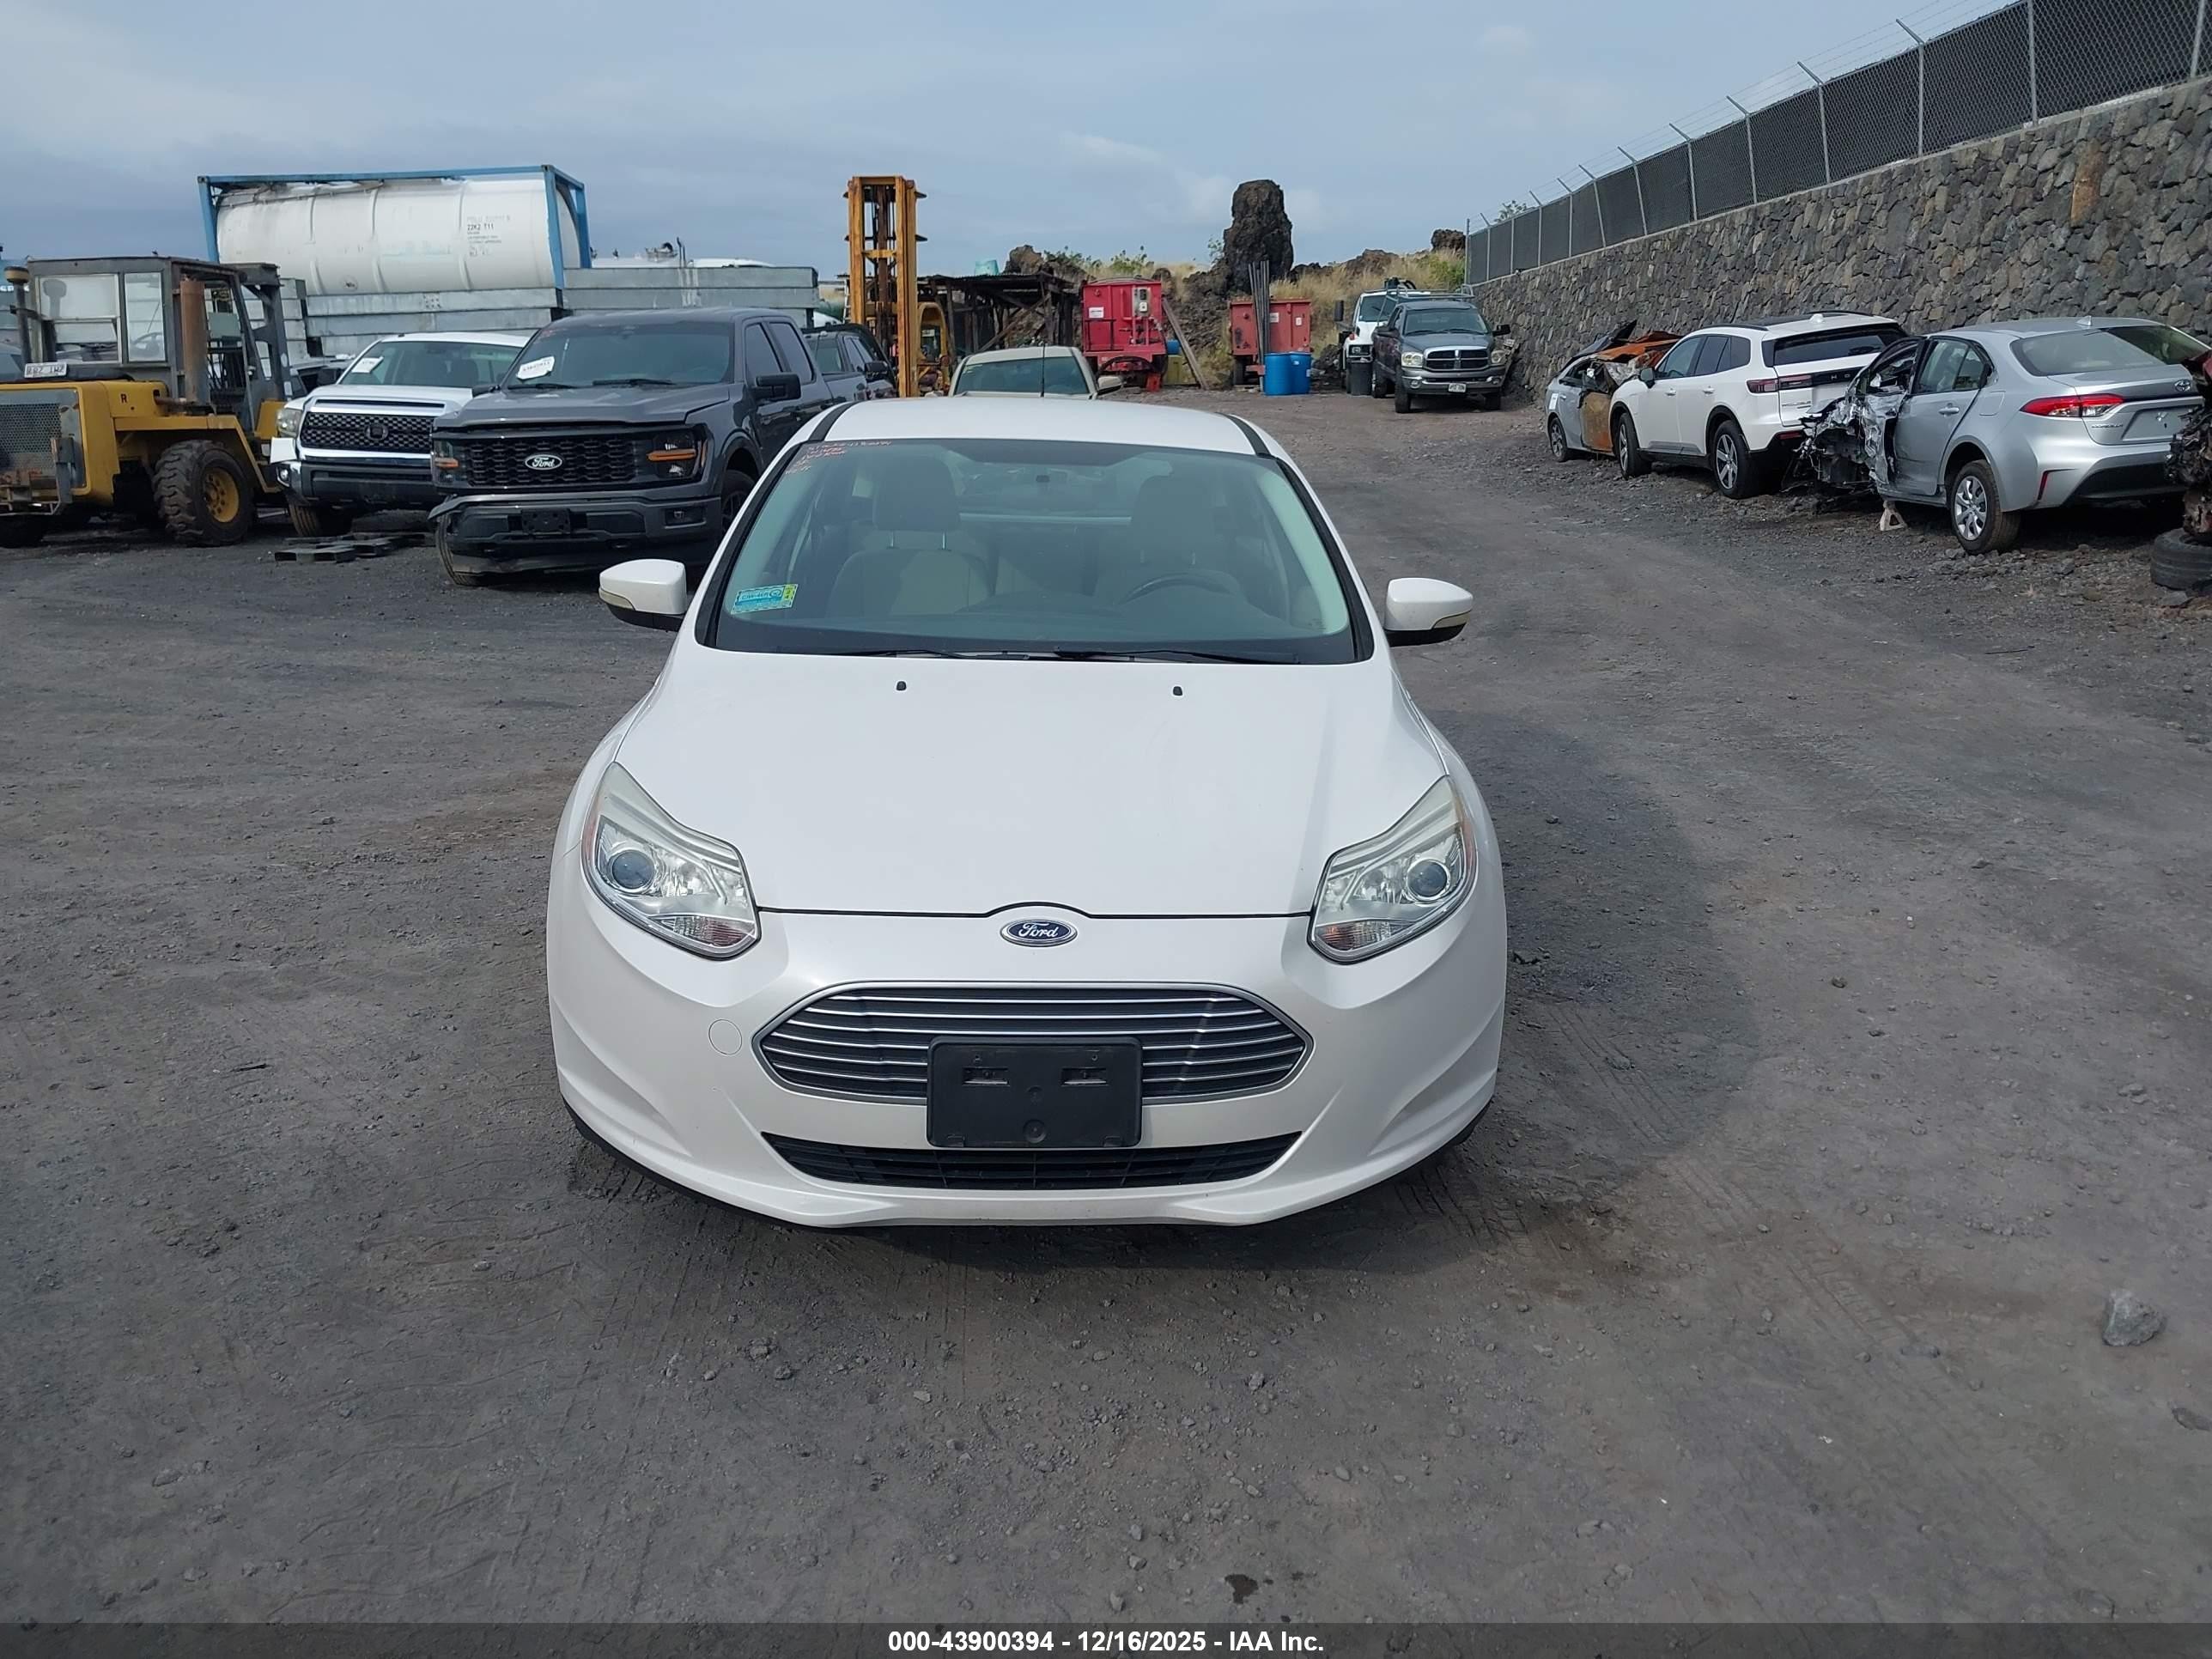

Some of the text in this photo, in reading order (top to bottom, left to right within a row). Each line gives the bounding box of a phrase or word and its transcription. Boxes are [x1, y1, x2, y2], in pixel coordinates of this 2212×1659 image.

[121, 393, 128, 404] R
[532, 457, 556, 468] Ford
[1018, 922, 1060, 938] Ford
